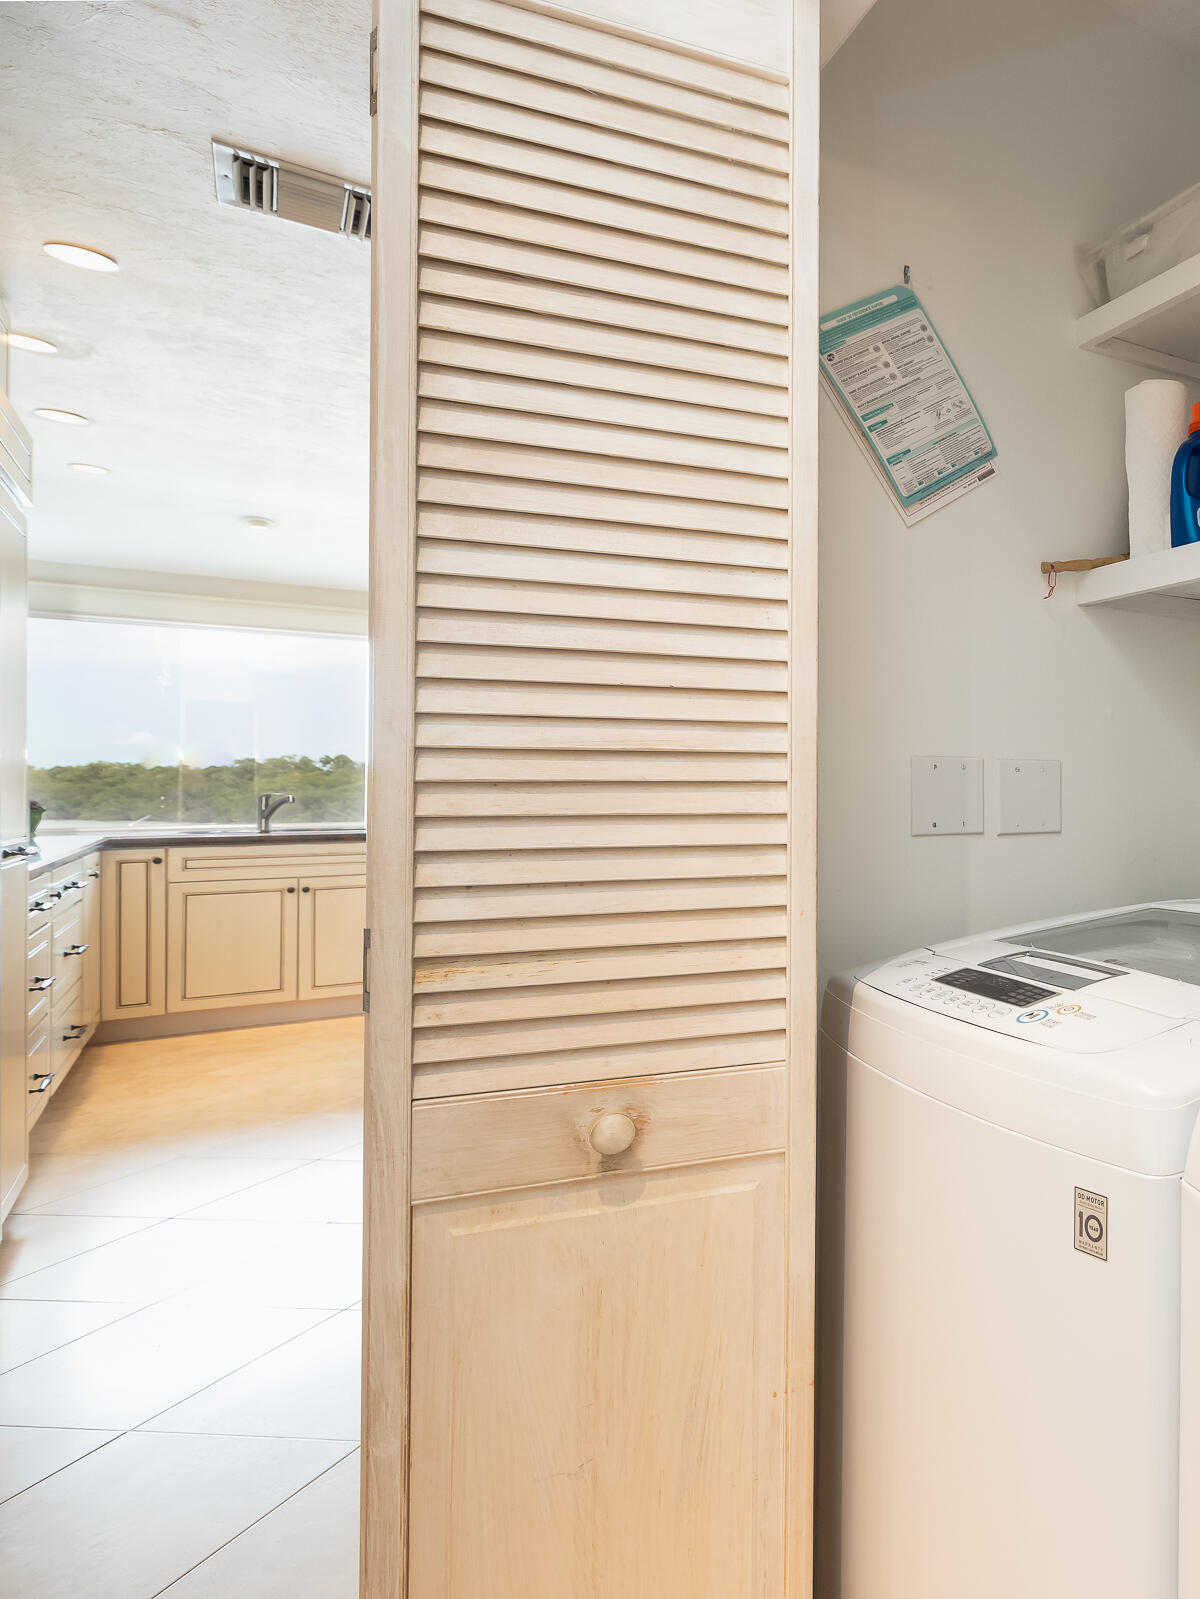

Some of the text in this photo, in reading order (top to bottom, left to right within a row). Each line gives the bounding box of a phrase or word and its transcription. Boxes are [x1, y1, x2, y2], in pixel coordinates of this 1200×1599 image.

[1077, 1192, 1086, 1200] DD
[1086, 1195, 1105, 1207] MOTOR
[1078, 1210, 1104, 1243] 10
